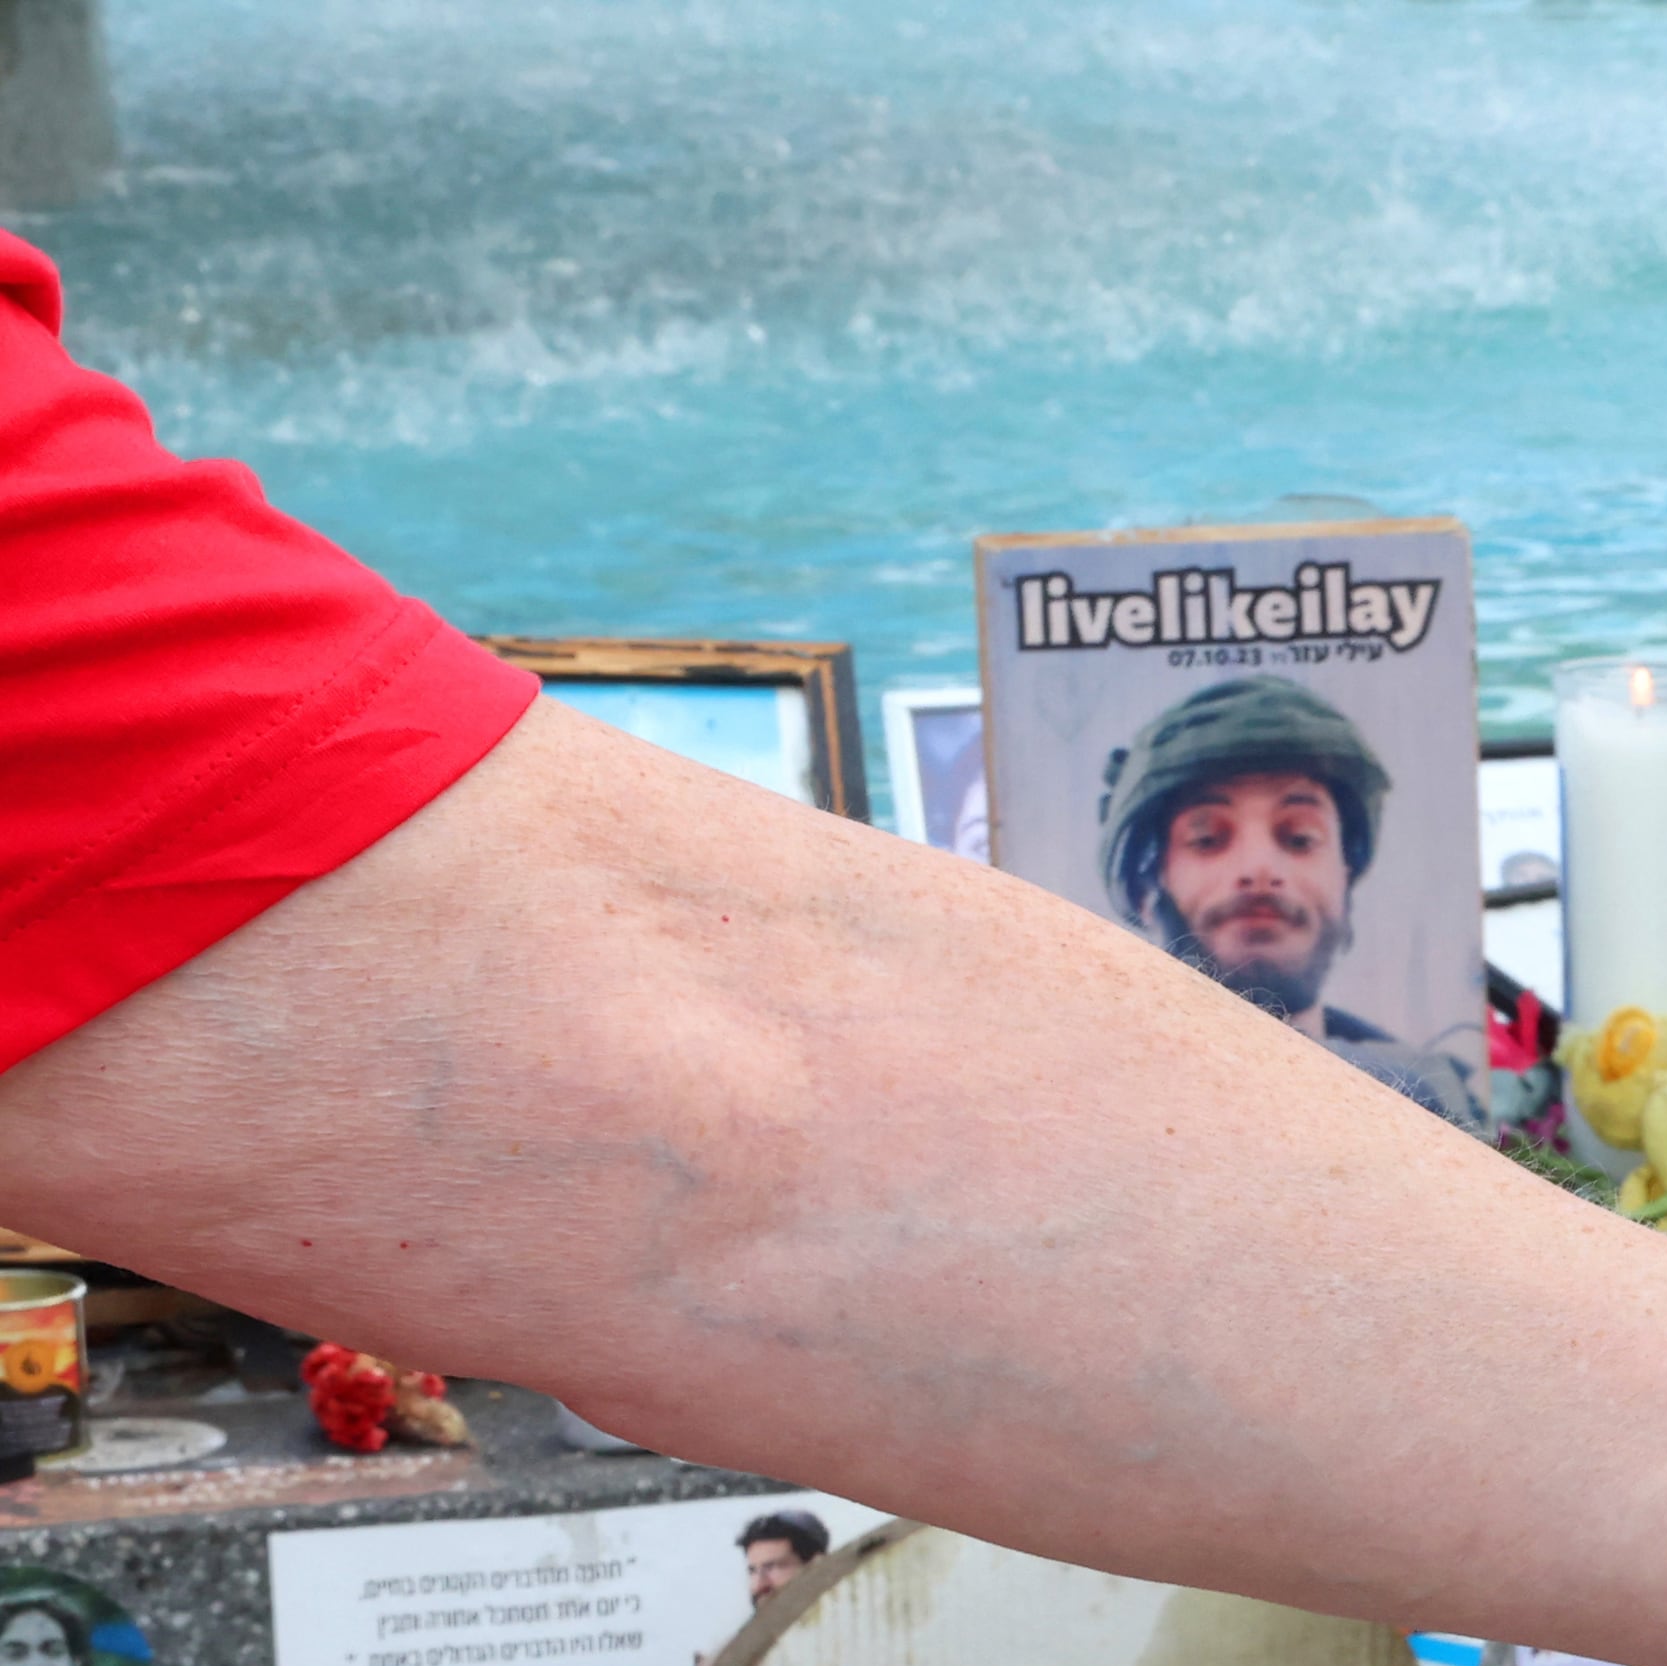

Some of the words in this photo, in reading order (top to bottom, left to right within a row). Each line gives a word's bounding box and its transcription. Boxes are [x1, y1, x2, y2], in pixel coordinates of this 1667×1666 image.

[1017, 562, 1441, 652] livelikeilay
[555, 1600, 590, 1622] אחד
[596, 1597, 620, 1617] יום
[625, 1594, 642, 1613] כי
[502, 1636, 566, 1662] הדברים
[571, 1634, 593, 1654] היו
[599, 1630, 643, 1651] שאלו
